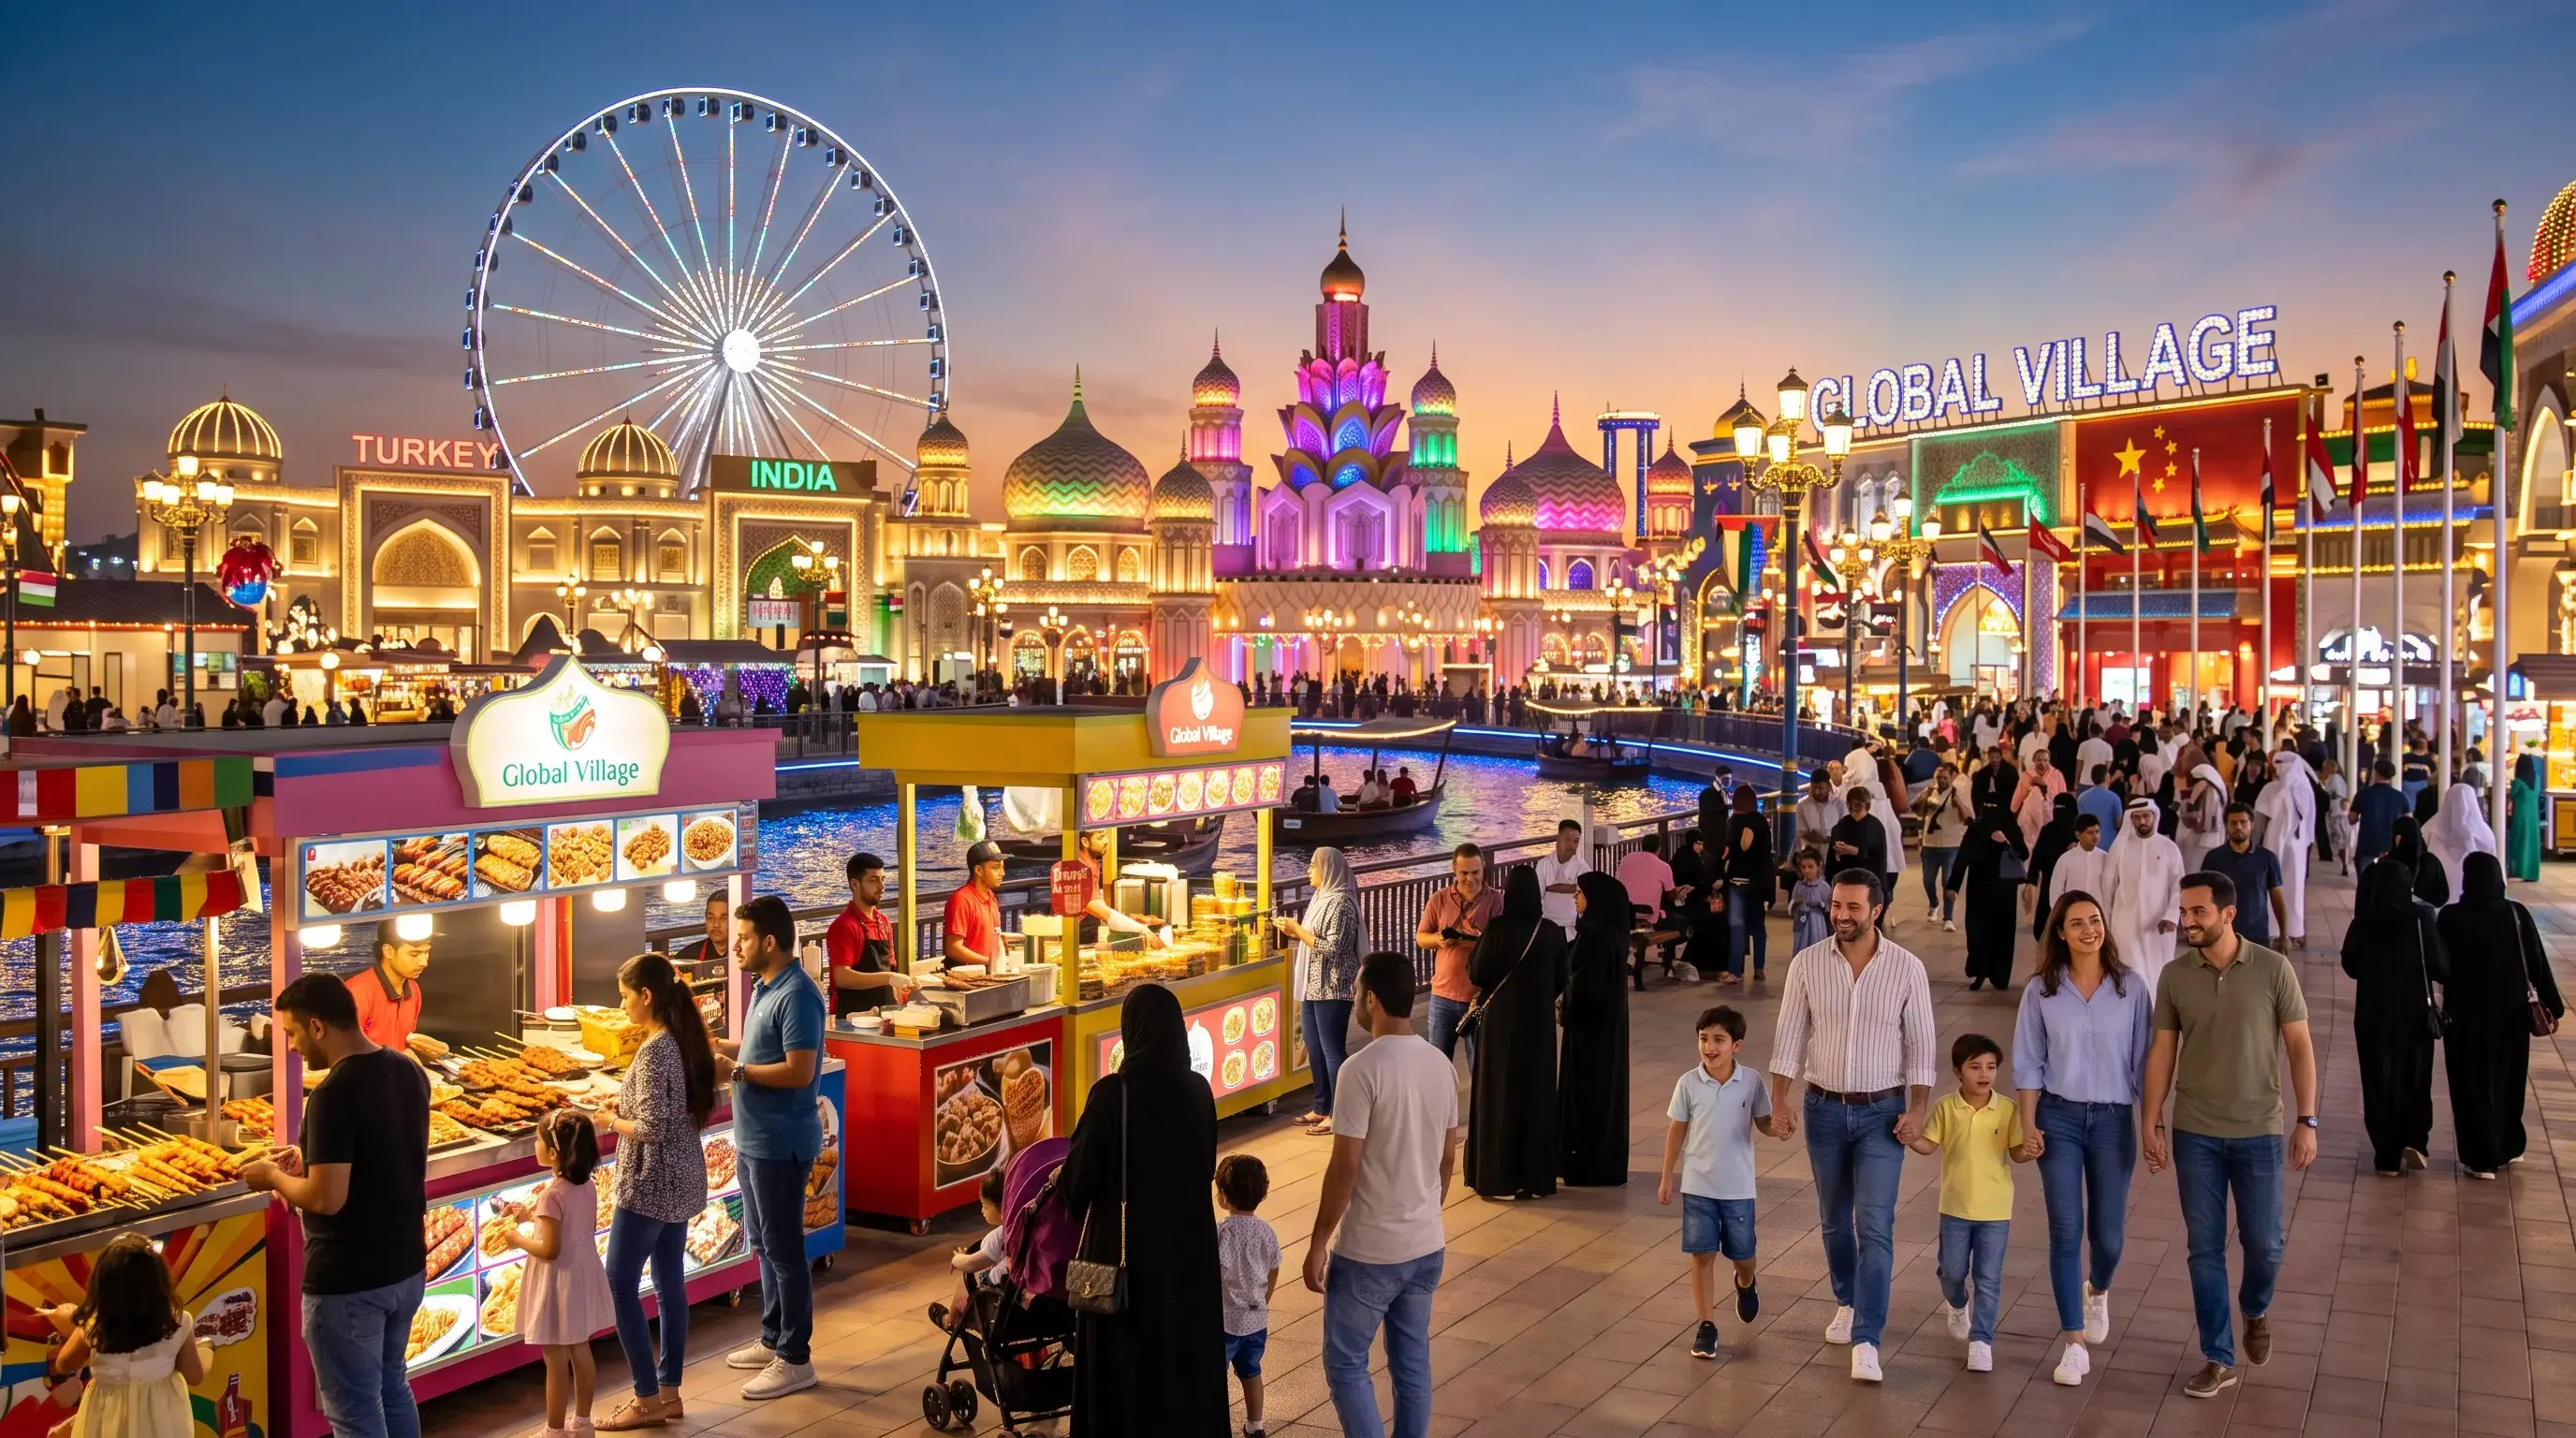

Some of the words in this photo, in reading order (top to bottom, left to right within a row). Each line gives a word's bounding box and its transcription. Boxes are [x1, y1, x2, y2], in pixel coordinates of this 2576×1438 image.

[1810, 353, 2003, 433] GLOBAL
[2013, 305, 2277, 405] VILLAGE
[351, 433, 500, 469] TURKEY
[751, 460, 838, 492] INDIA
[1169, 726, 1201, 744] Global
[1201, 725, 1234, 746] Village
[503, 760, 567, 787] Global
[574, 758, 639, 786] Village
